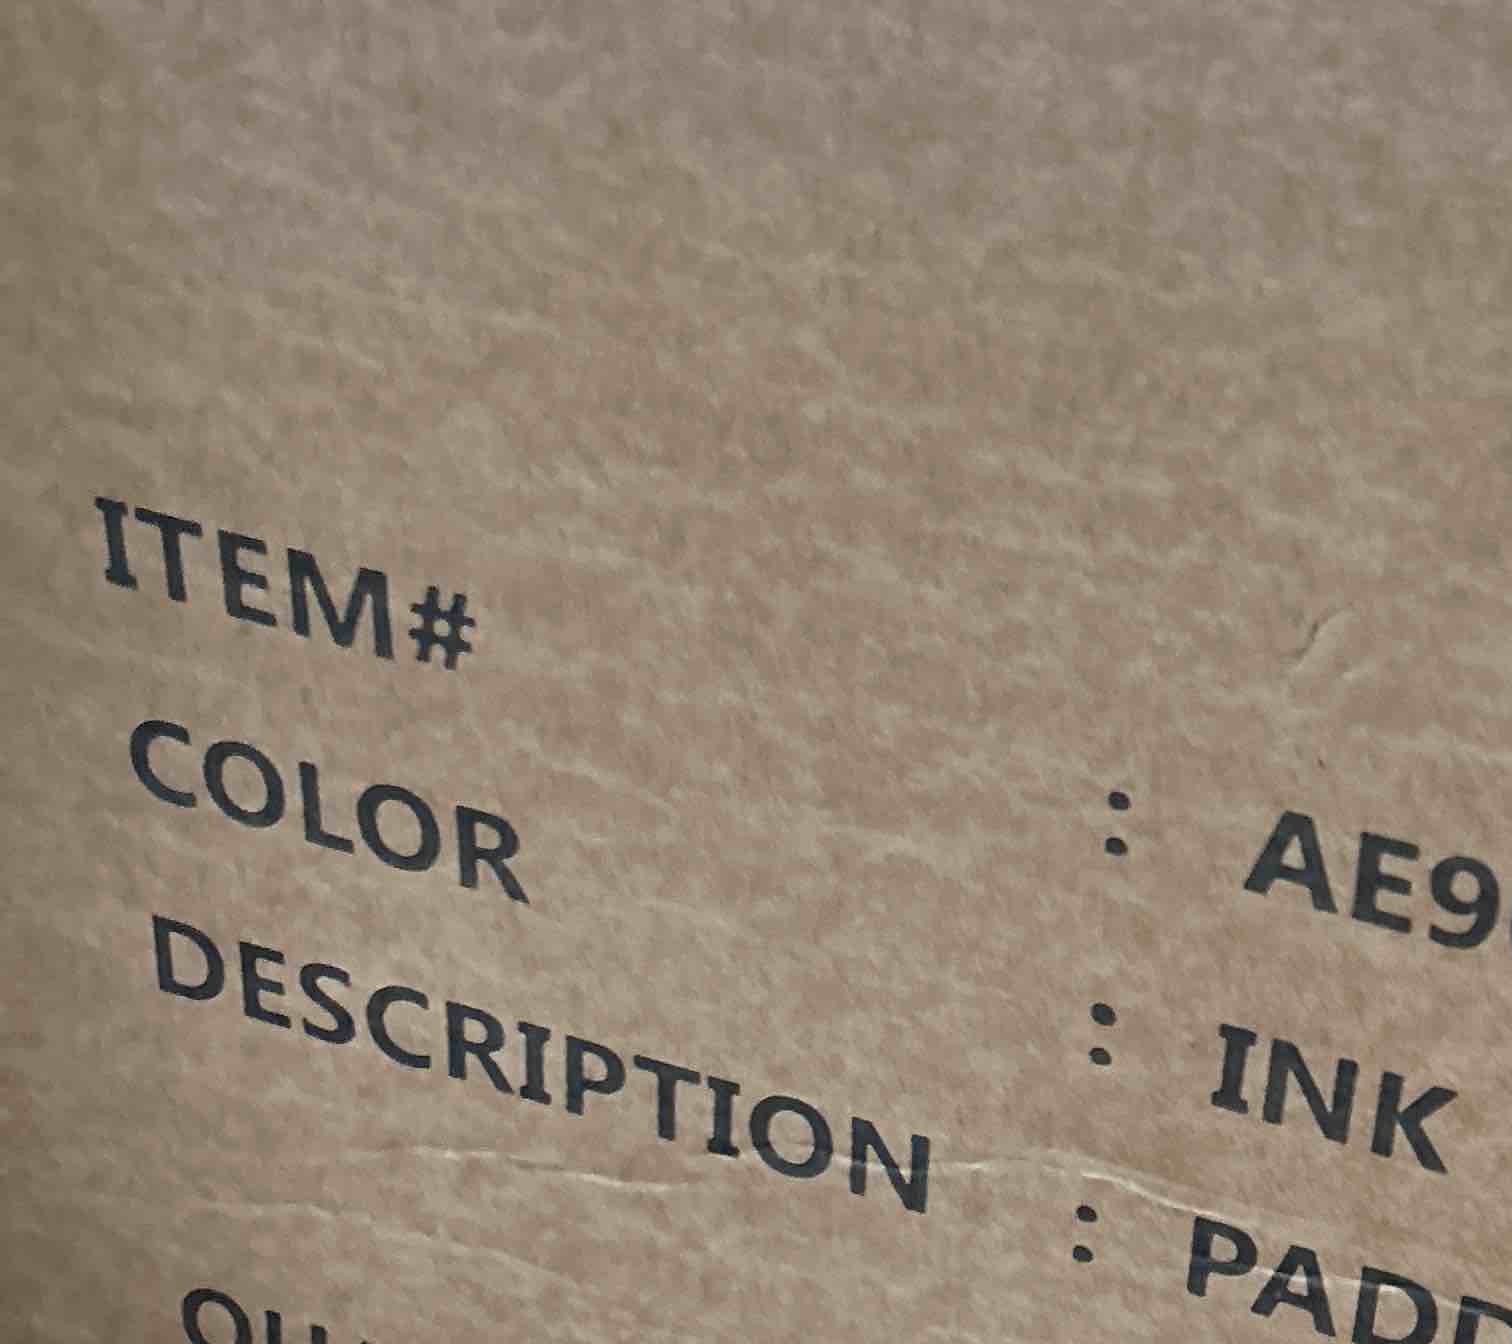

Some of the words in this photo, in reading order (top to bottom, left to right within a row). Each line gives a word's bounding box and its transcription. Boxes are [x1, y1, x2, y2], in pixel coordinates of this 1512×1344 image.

[95, 497, 475, 669] ITEM#
[130, 720, 529, 904] COLOR
[1212, 1024, 1458, 1173] INK
[152, 915, 930, 1213] DESCRIPTION
